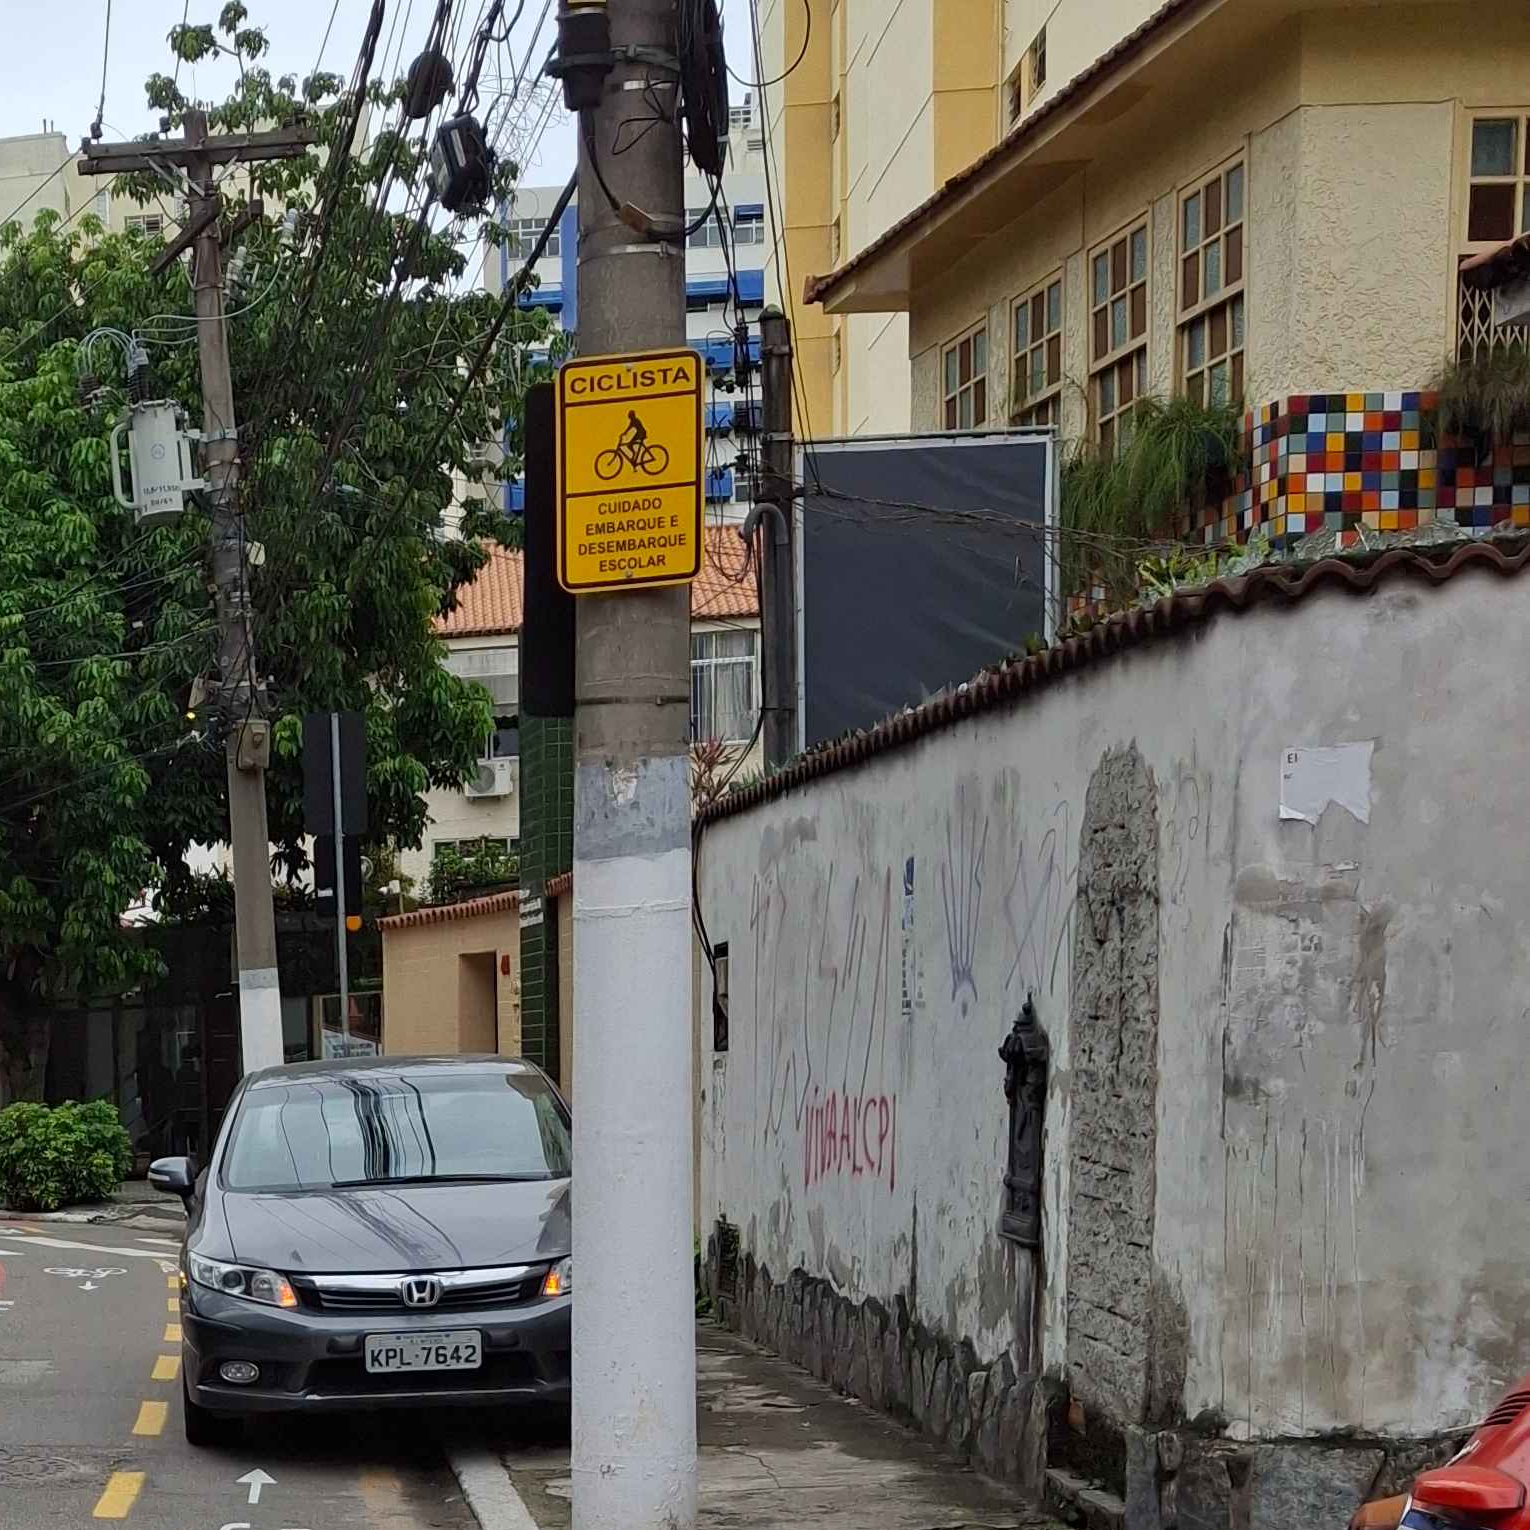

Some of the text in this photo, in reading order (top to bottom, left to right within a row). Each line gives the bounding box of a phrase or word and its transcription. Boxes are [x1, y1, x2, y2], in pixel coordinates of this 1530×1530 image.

[570, 366, 691, 395] CICLISTA
[597, 497, 663, 516] CUIDADO
[585, 514, 679, 537] EMBARQUE E
[577, 533, 687, 556] DESEMBARQUE
[598, 554, 666, 573] ESCOLAR
